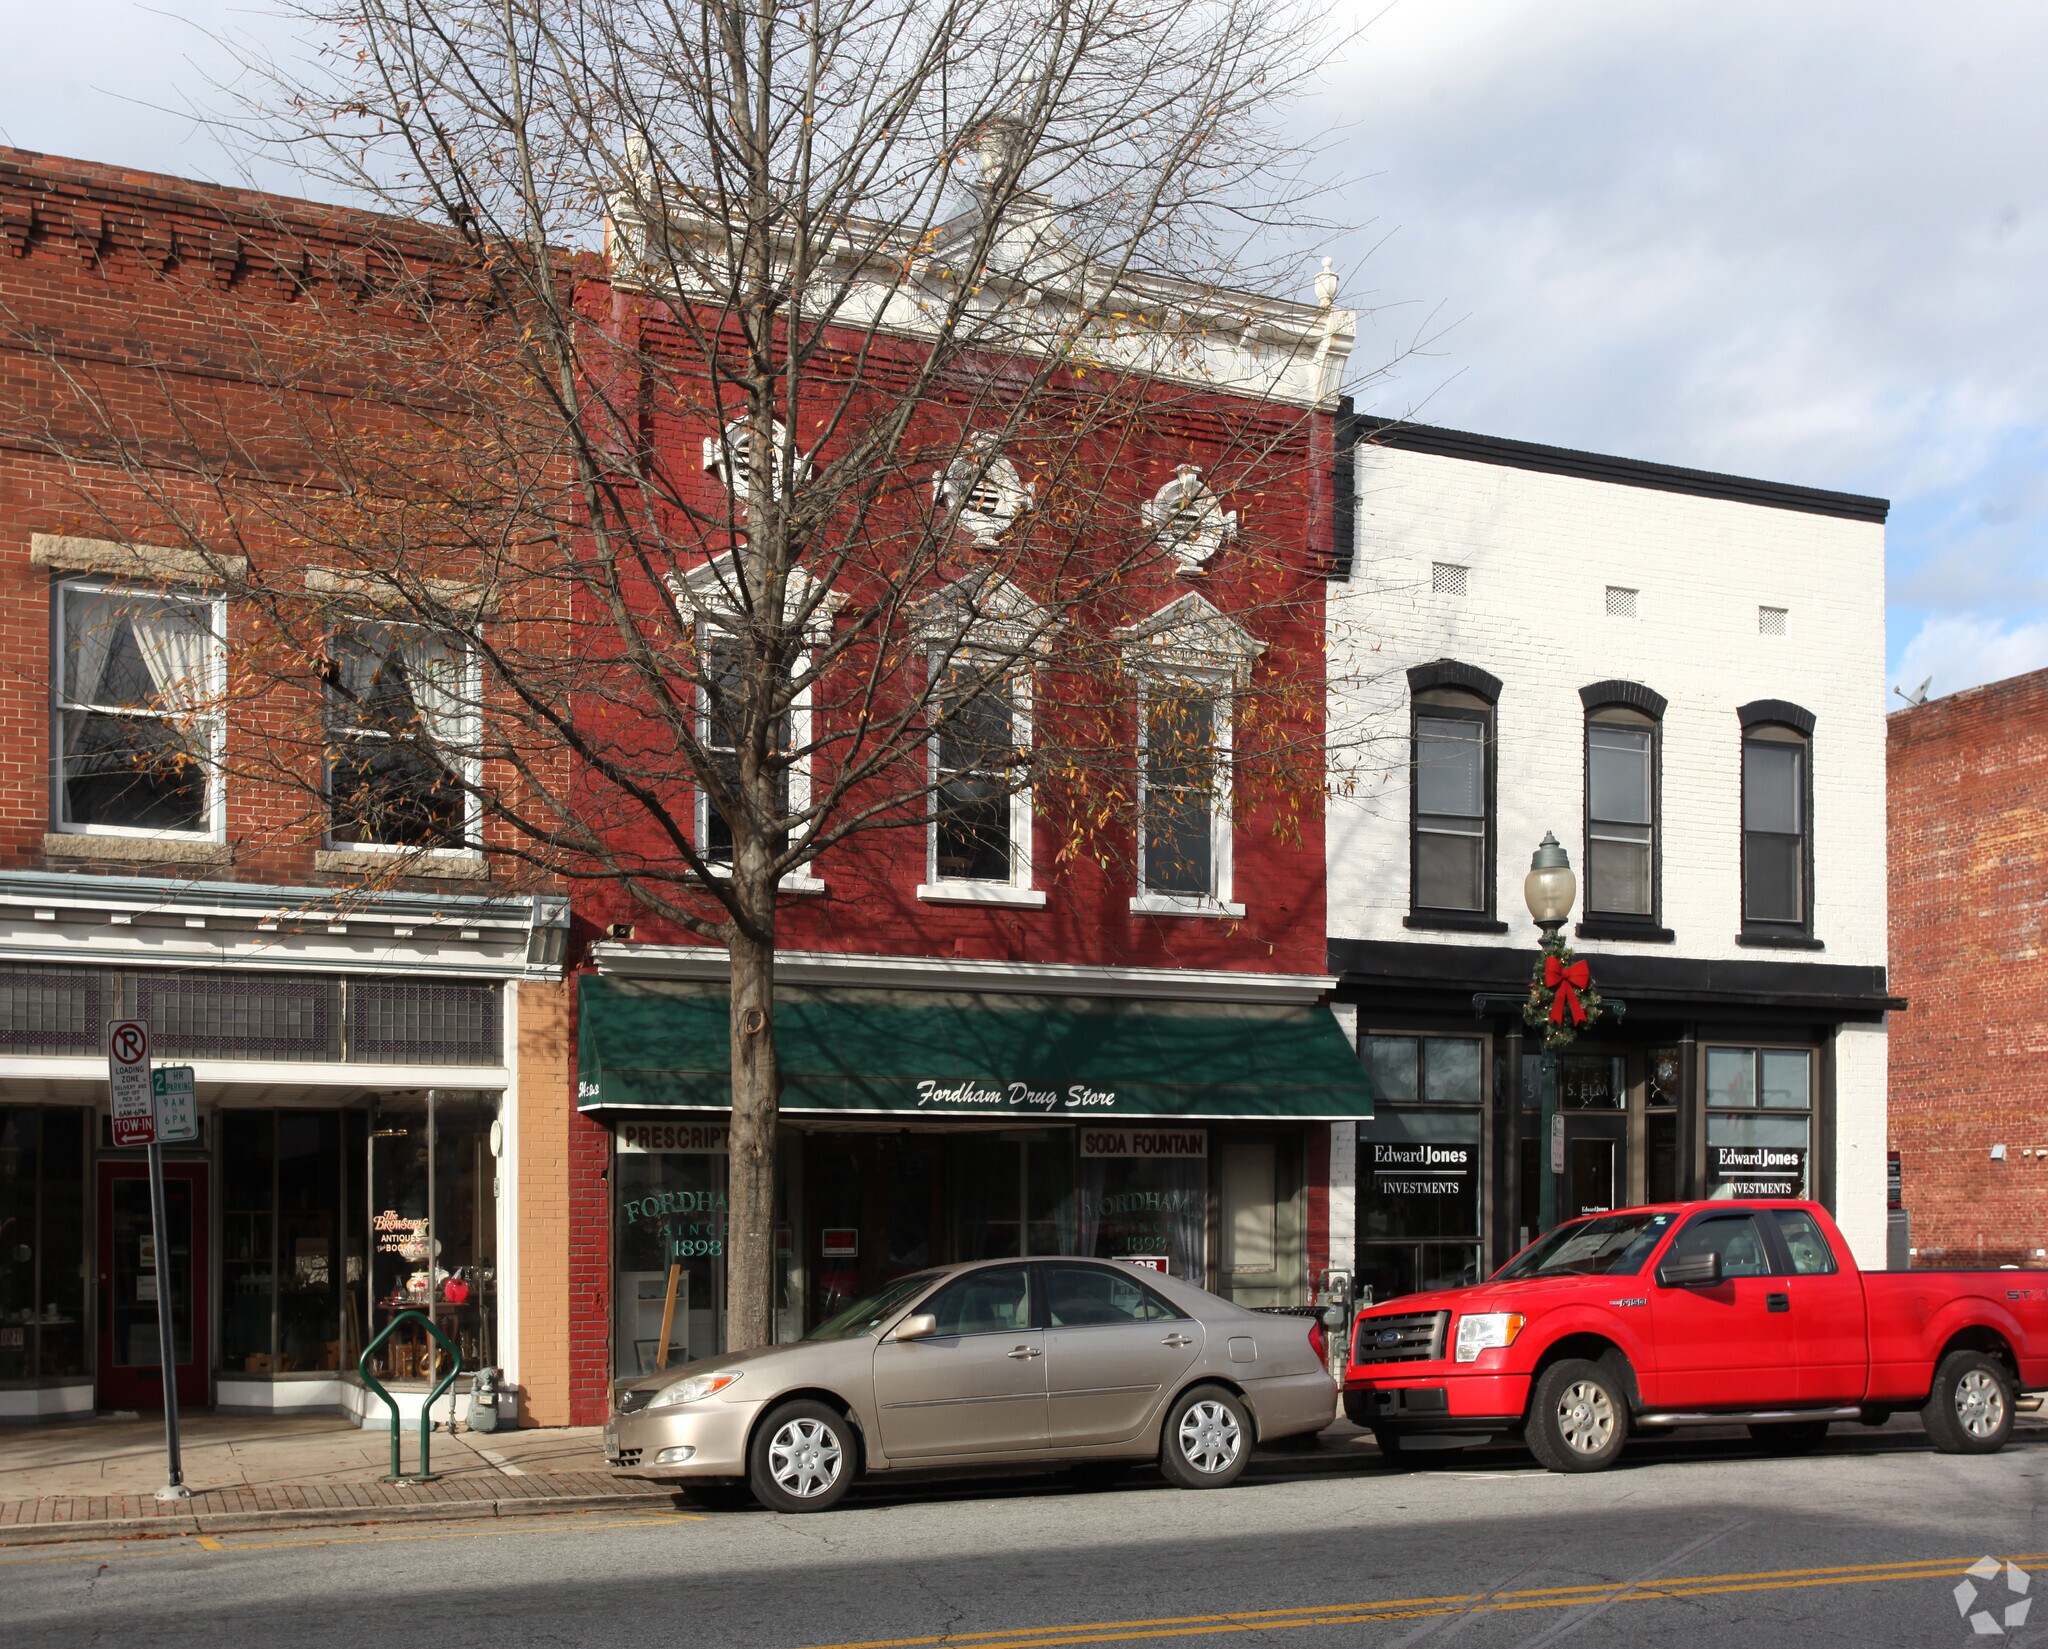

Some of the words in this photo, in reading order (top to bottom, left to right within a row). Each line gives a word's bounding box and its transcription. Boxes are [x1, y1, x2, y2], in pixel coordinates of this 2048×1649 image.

[115, 1066, 145, 1075] LOADING
[121, 1075, 140, 1083] ZONE
[173, 1072, 184, 1081] HR
[155, 1073, 165, 1092] 2
[167, 1081, 192, 1092] PARKING
[916, 1080, 1002, 1106] Fordham
[1007, 1082, 1058, 1111] Drug
[1064, 1085, 1116, 1107] Store
[1581, 1083, 1609, 1097] ELM
[164, 1098, 169, 1107] 9
[115, 1118, 152, 1132] TOW-IN
[165, 1116, 170, 1125] 6
[1085, 1133, 1126, 1154] SODA
[1132, 1134, 1203, 1155] FOUNTAIN
[1383, 1182, 1459, 1194] INVESTMENTS
[1727, 1183, 1792, 1194] INVESTMENTS
[383, 1210, 399, 1220] The
[663, 1223, 729, 1236] SINCE
[381, 1234, 421, 1243] ANTIQUES
[1127, 1236, 1167, 1252] 1898
[672, 1239, 723, 1257] 1898
